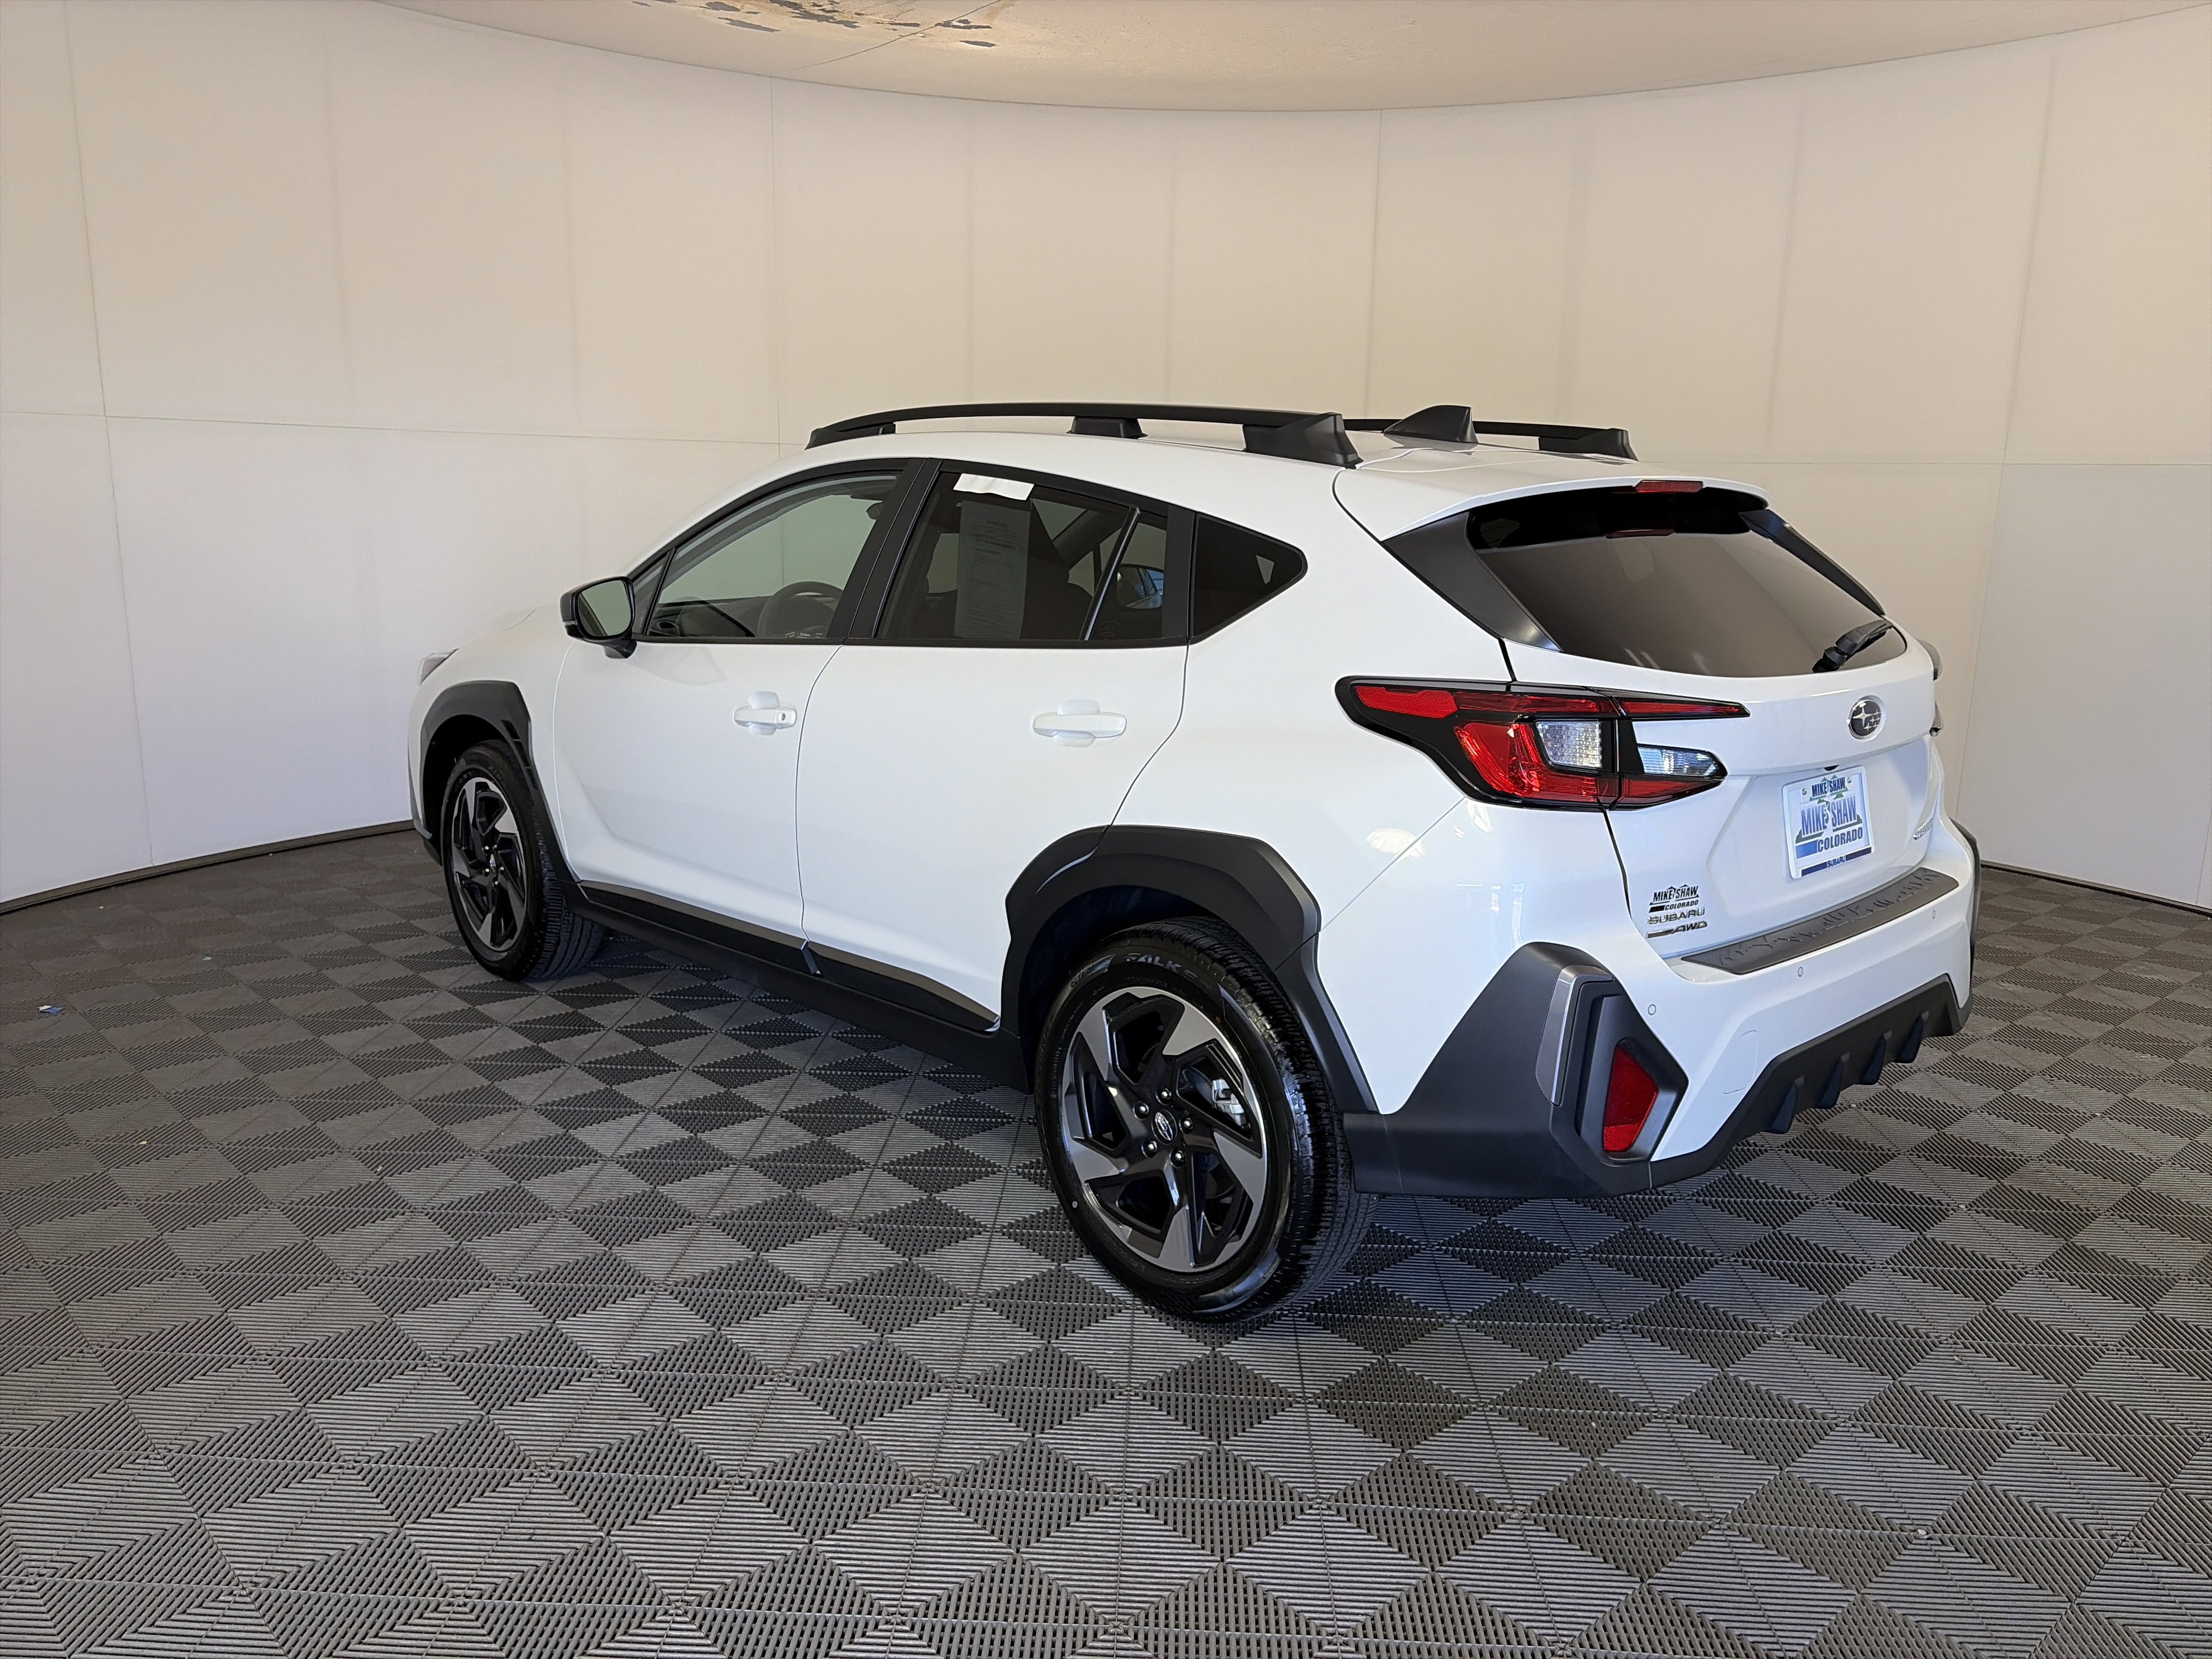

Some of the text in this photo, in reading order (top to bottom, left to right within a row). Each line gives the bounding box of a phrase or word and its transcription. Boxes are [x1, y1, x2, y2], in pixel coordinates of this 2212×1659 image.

[1812, 777, 1846, 797] MIKE SHAW
[1801, 795, 1857, 836] MIKE SHAW
[1818, 827, 1863, 853] COLORADO
[1827, 855, 1846, 868] SUBARU
[1653, 885, 1699, 902] MIKE SHAW
[1664, 900, 1699, 911] COLORADO
[1647, 906, 1705, 924] SUBARU
[1673, 921, 1708, 933] AWD
